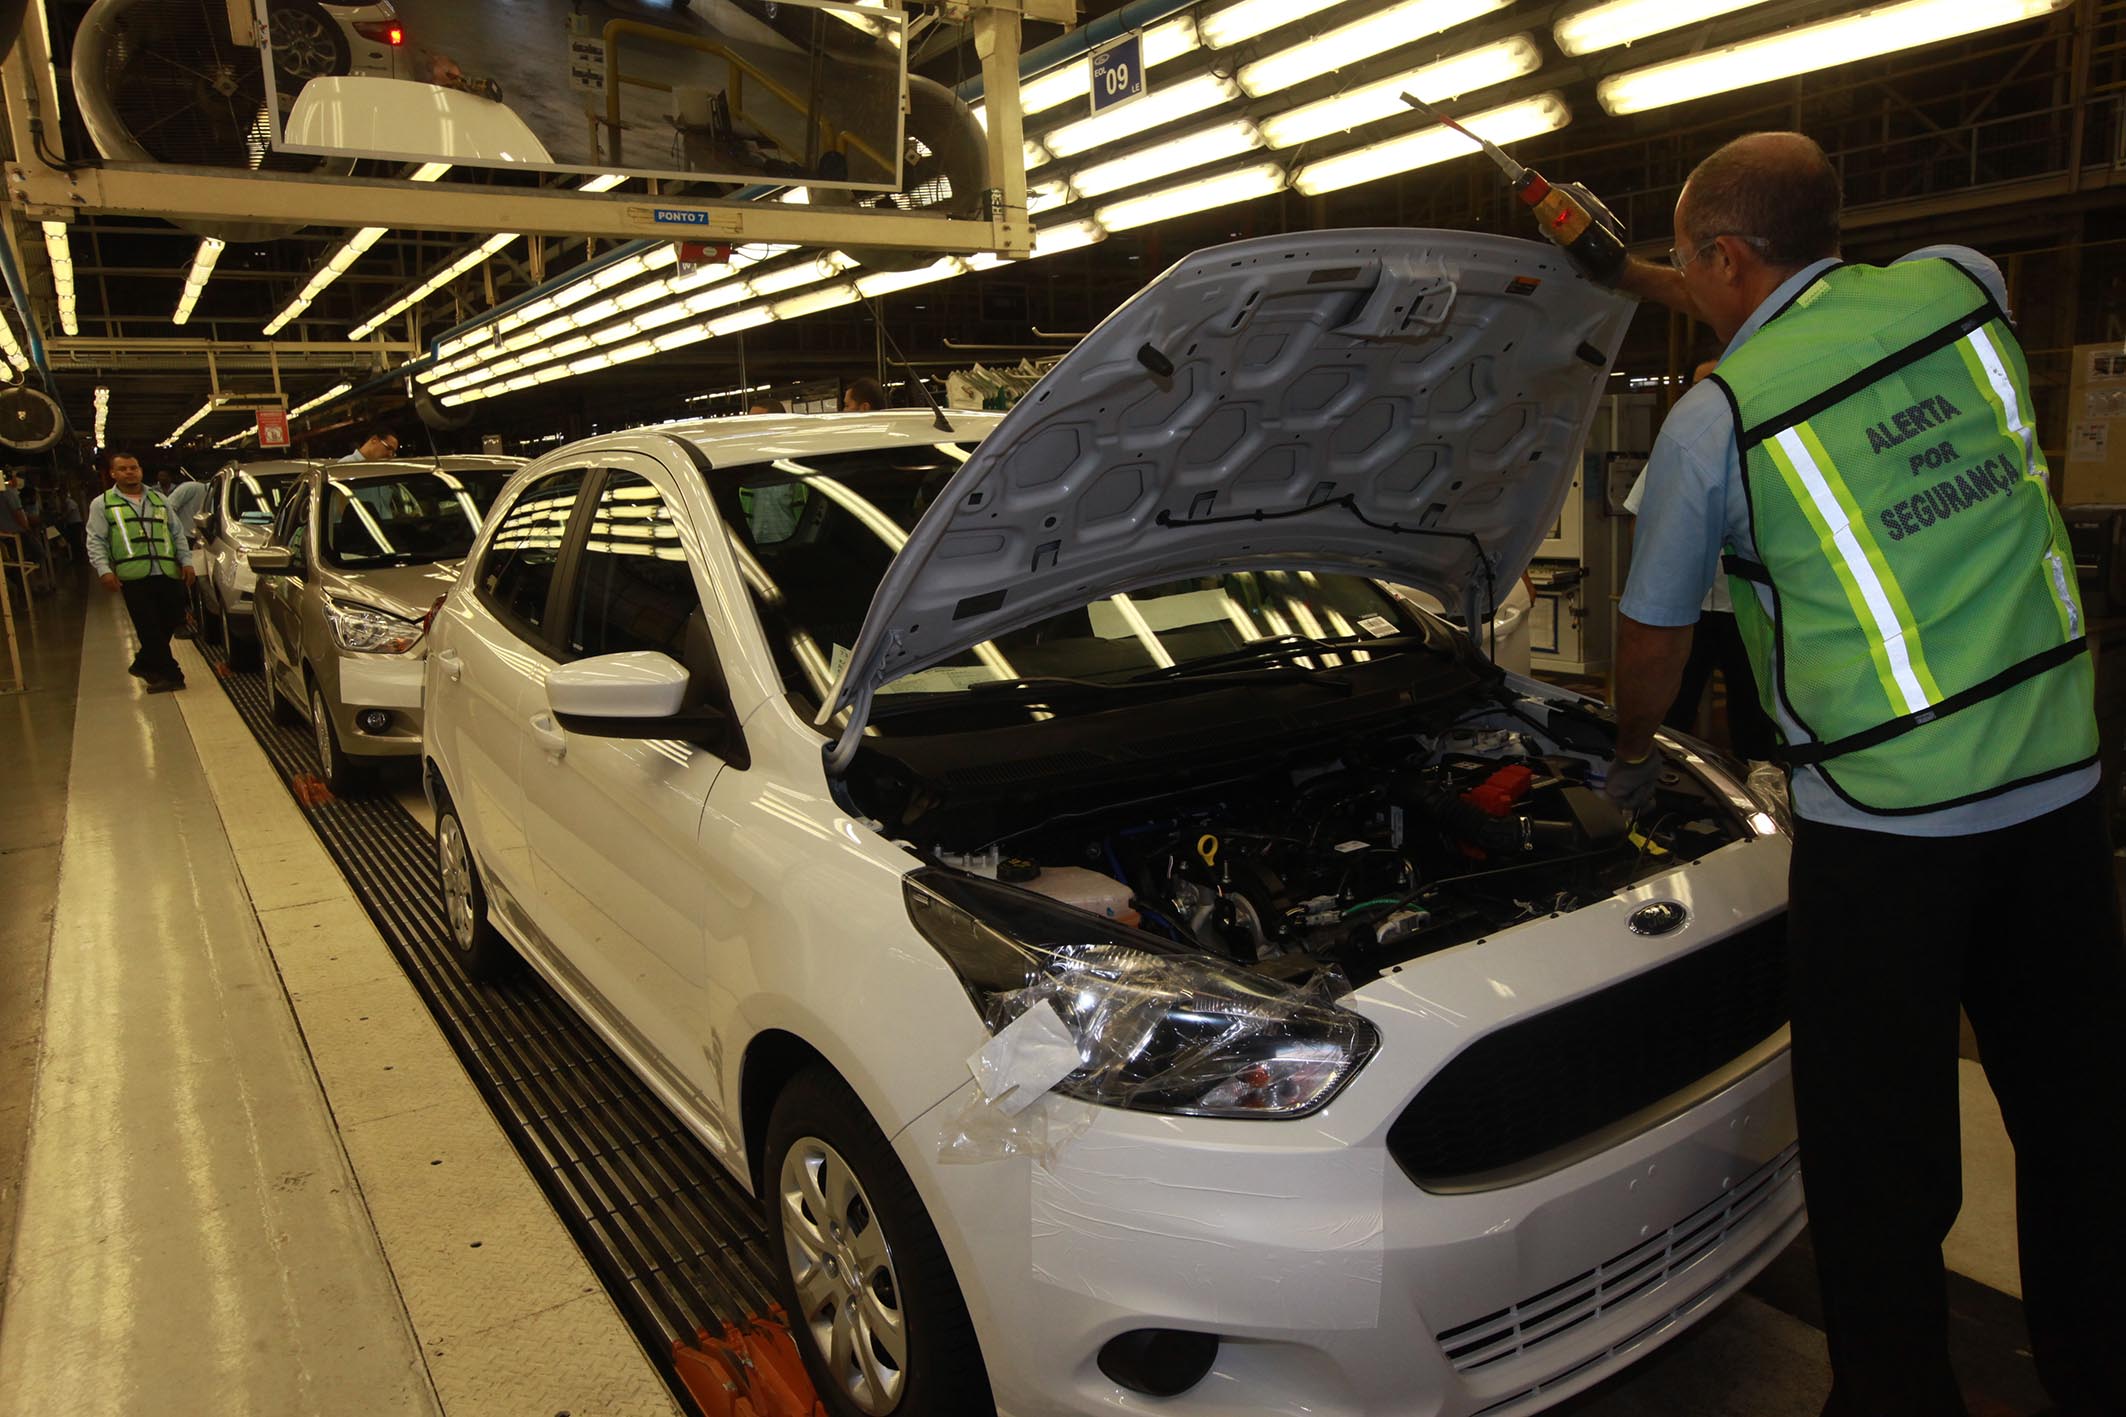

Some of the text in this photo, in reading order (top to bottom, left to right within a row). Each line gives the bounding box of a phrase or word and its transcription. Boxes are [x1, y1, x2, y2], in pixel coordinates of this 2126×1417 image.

[1094, 67, 1106, 78] EOL
[1106, 63, 1128, 95] 09
[1131, 82, 1141, 93] LE
[658, 211, 705, 222] PONTO 7
[1865, 394, 1962, 455] ALERTA
[1909, 441, 1960, 477] POR
[1880, 453, 2019, 541] SEGURANÇA
